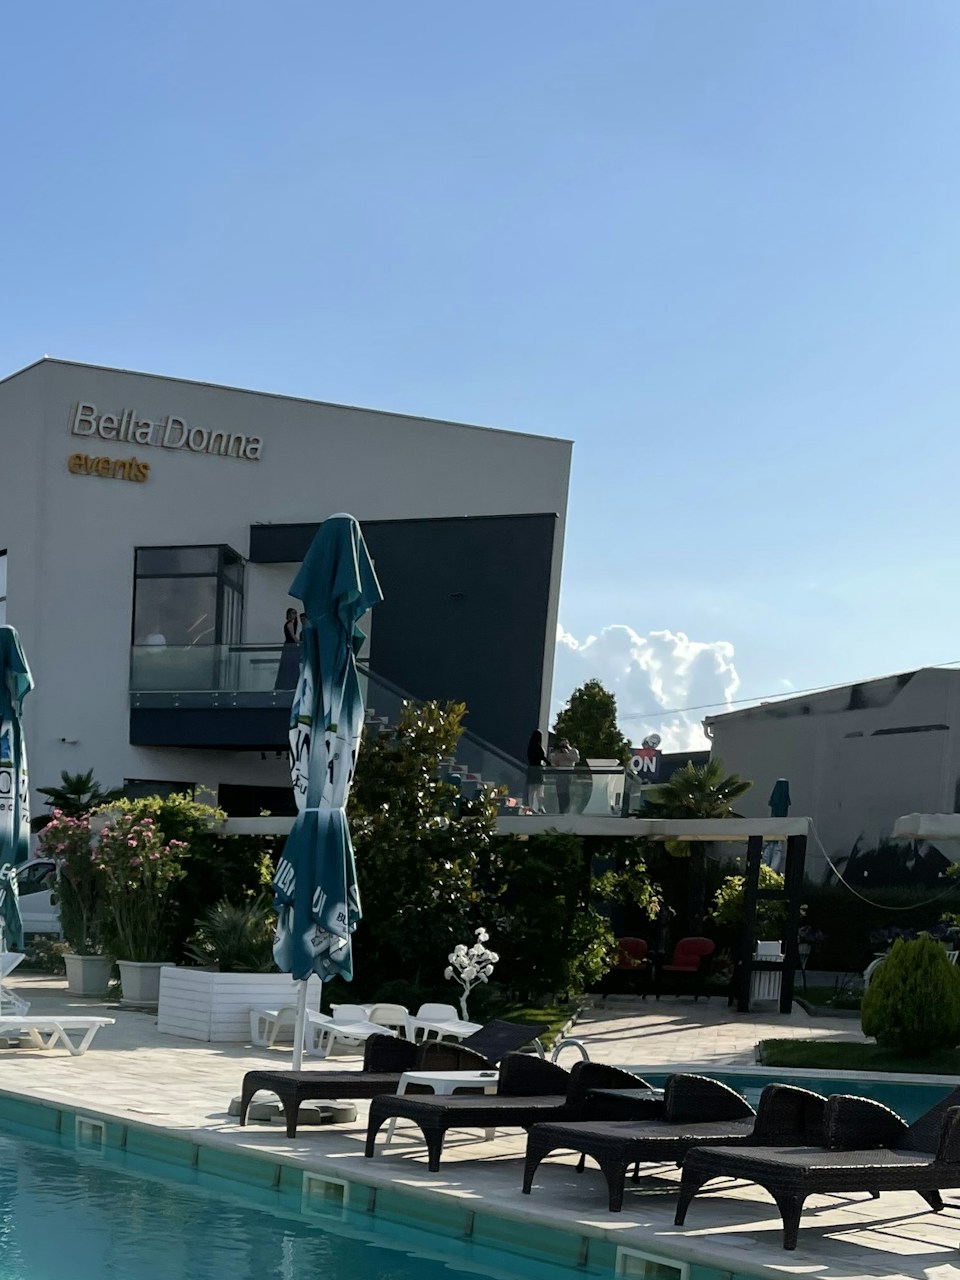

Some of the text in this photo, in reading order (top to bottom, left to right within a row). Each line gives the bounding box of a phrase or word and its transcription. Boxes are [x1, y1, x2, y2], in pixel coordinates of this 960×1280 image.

[72, 401, 264, 460] Bella Donna
[67, 452, 150, 483] events
